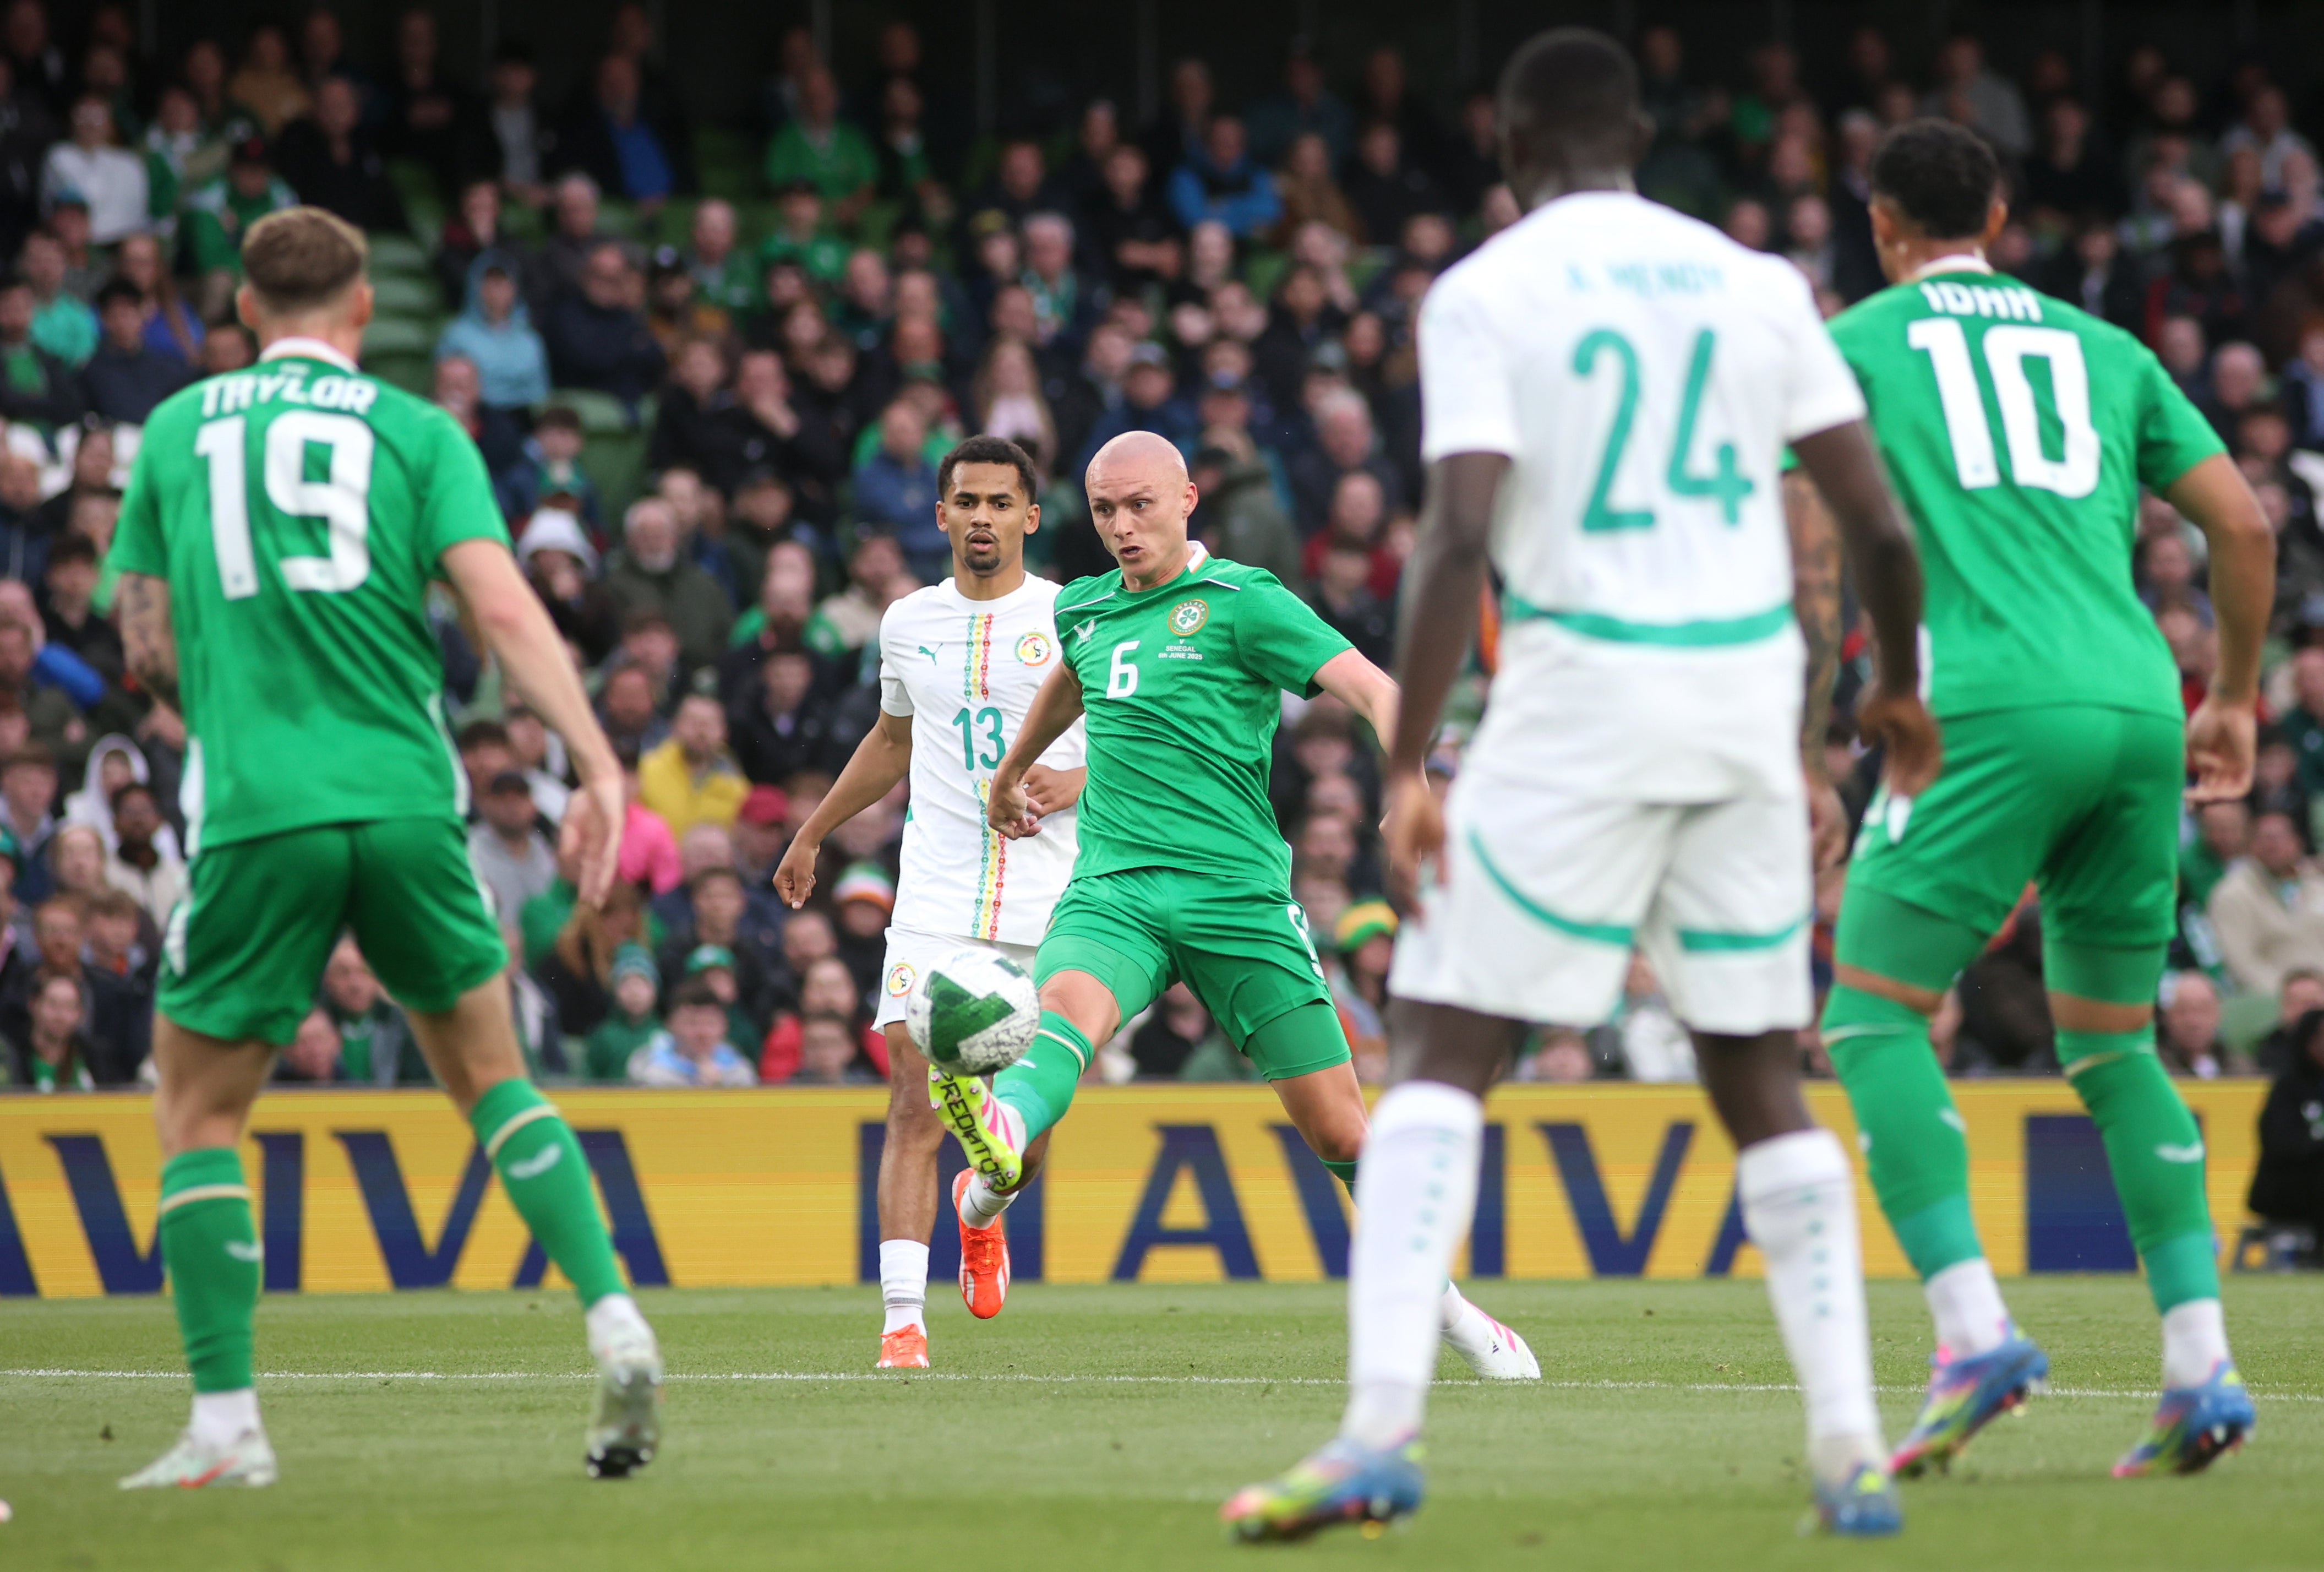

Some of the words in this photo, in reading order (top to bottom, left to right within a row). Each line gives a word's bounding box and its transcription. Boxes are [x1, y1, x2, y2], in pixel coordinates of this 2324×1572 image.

[201, 374, 378, 417] TAYLOR
[1573, 329, 1755, 534] 24
[1907, 317, 2101, 499] 10
[194, 409, 375, 601] 19
[952, 706, 1006, 771] 13
[1106, 640, 1141, 699] 6
[1110, 1122, 1750, 1281] AIV
